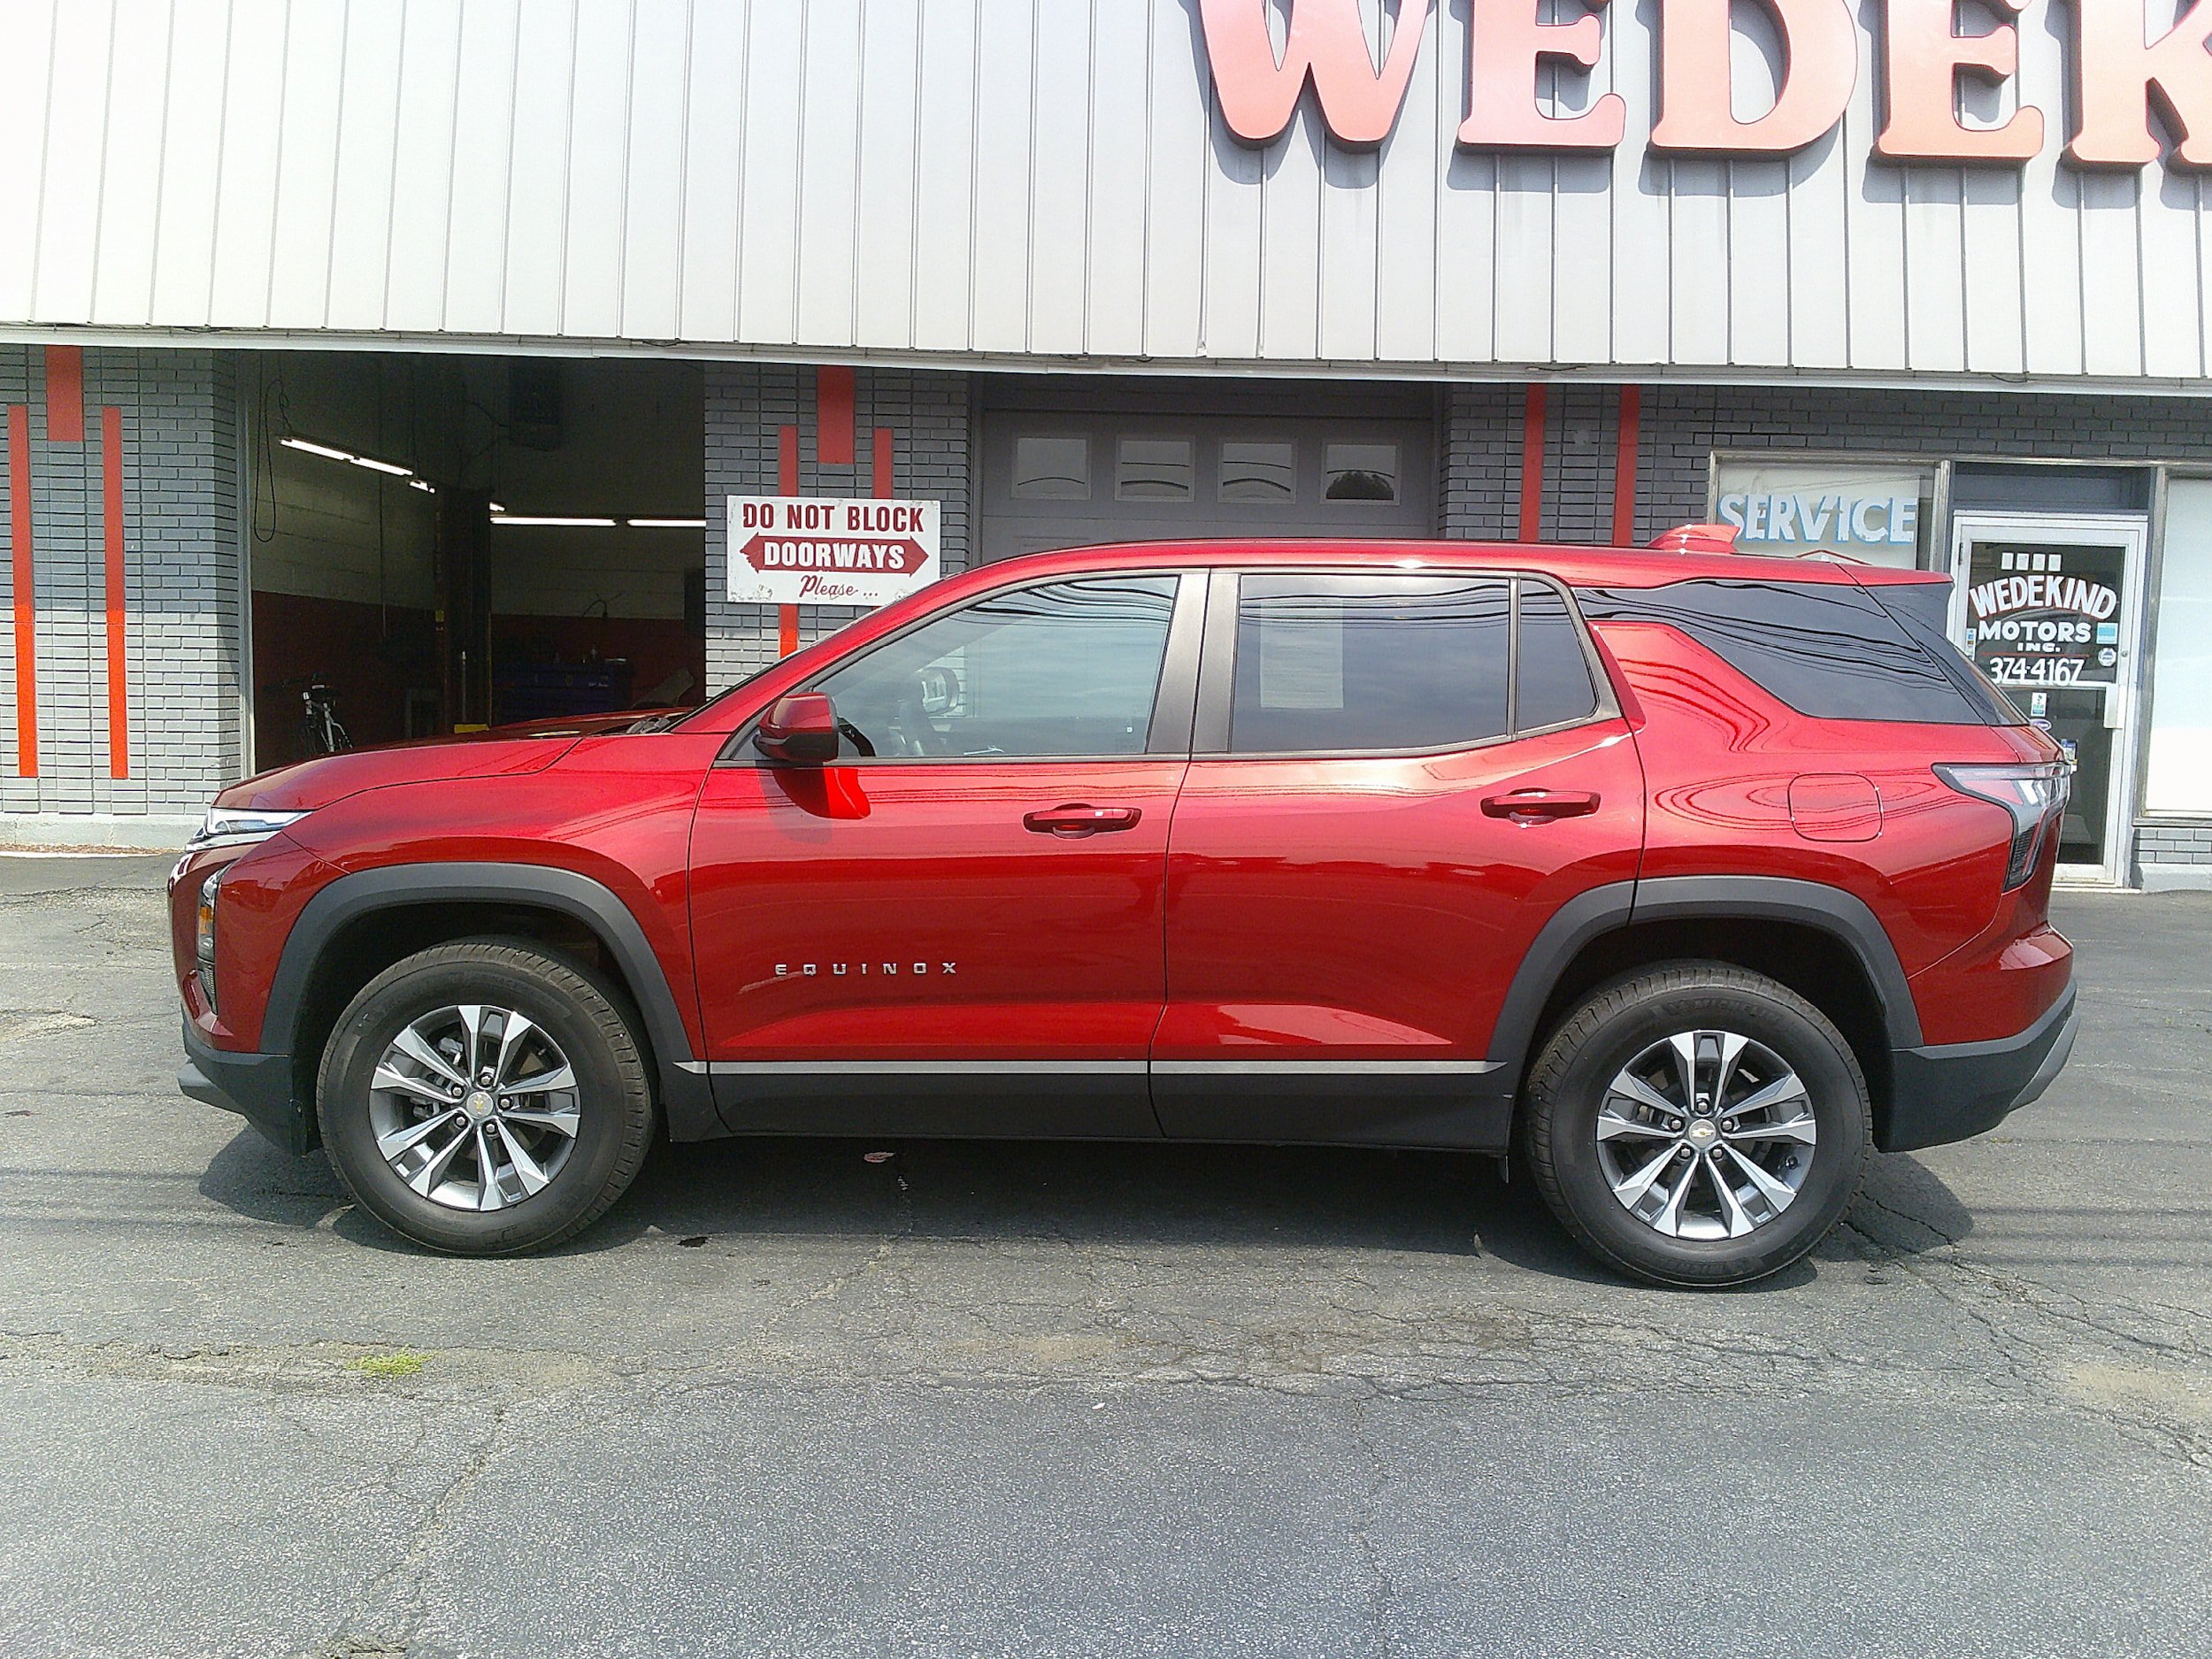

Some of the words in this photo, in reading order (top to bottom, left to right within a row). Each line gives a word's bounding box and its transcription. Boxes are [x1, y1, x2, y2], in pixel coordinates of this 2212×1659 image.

[742, 503, 775, 529] DO
[787, 504, 835, 530] NOT
[848, 505, 925, 533] BLOCK
[1718, 493, 1919, 543] SERVICE
[763, 541, 906, 570] DOORWAYS
[1969, 574, 2117, 619] WEDEKIND
[1978, 620, 2092, 644] MOTORS
[2016, 642, 2062, 652] INC.
[1989, 657, 2085, 686] 374-4167
[774, 962, 956, 976] EQUINOX
